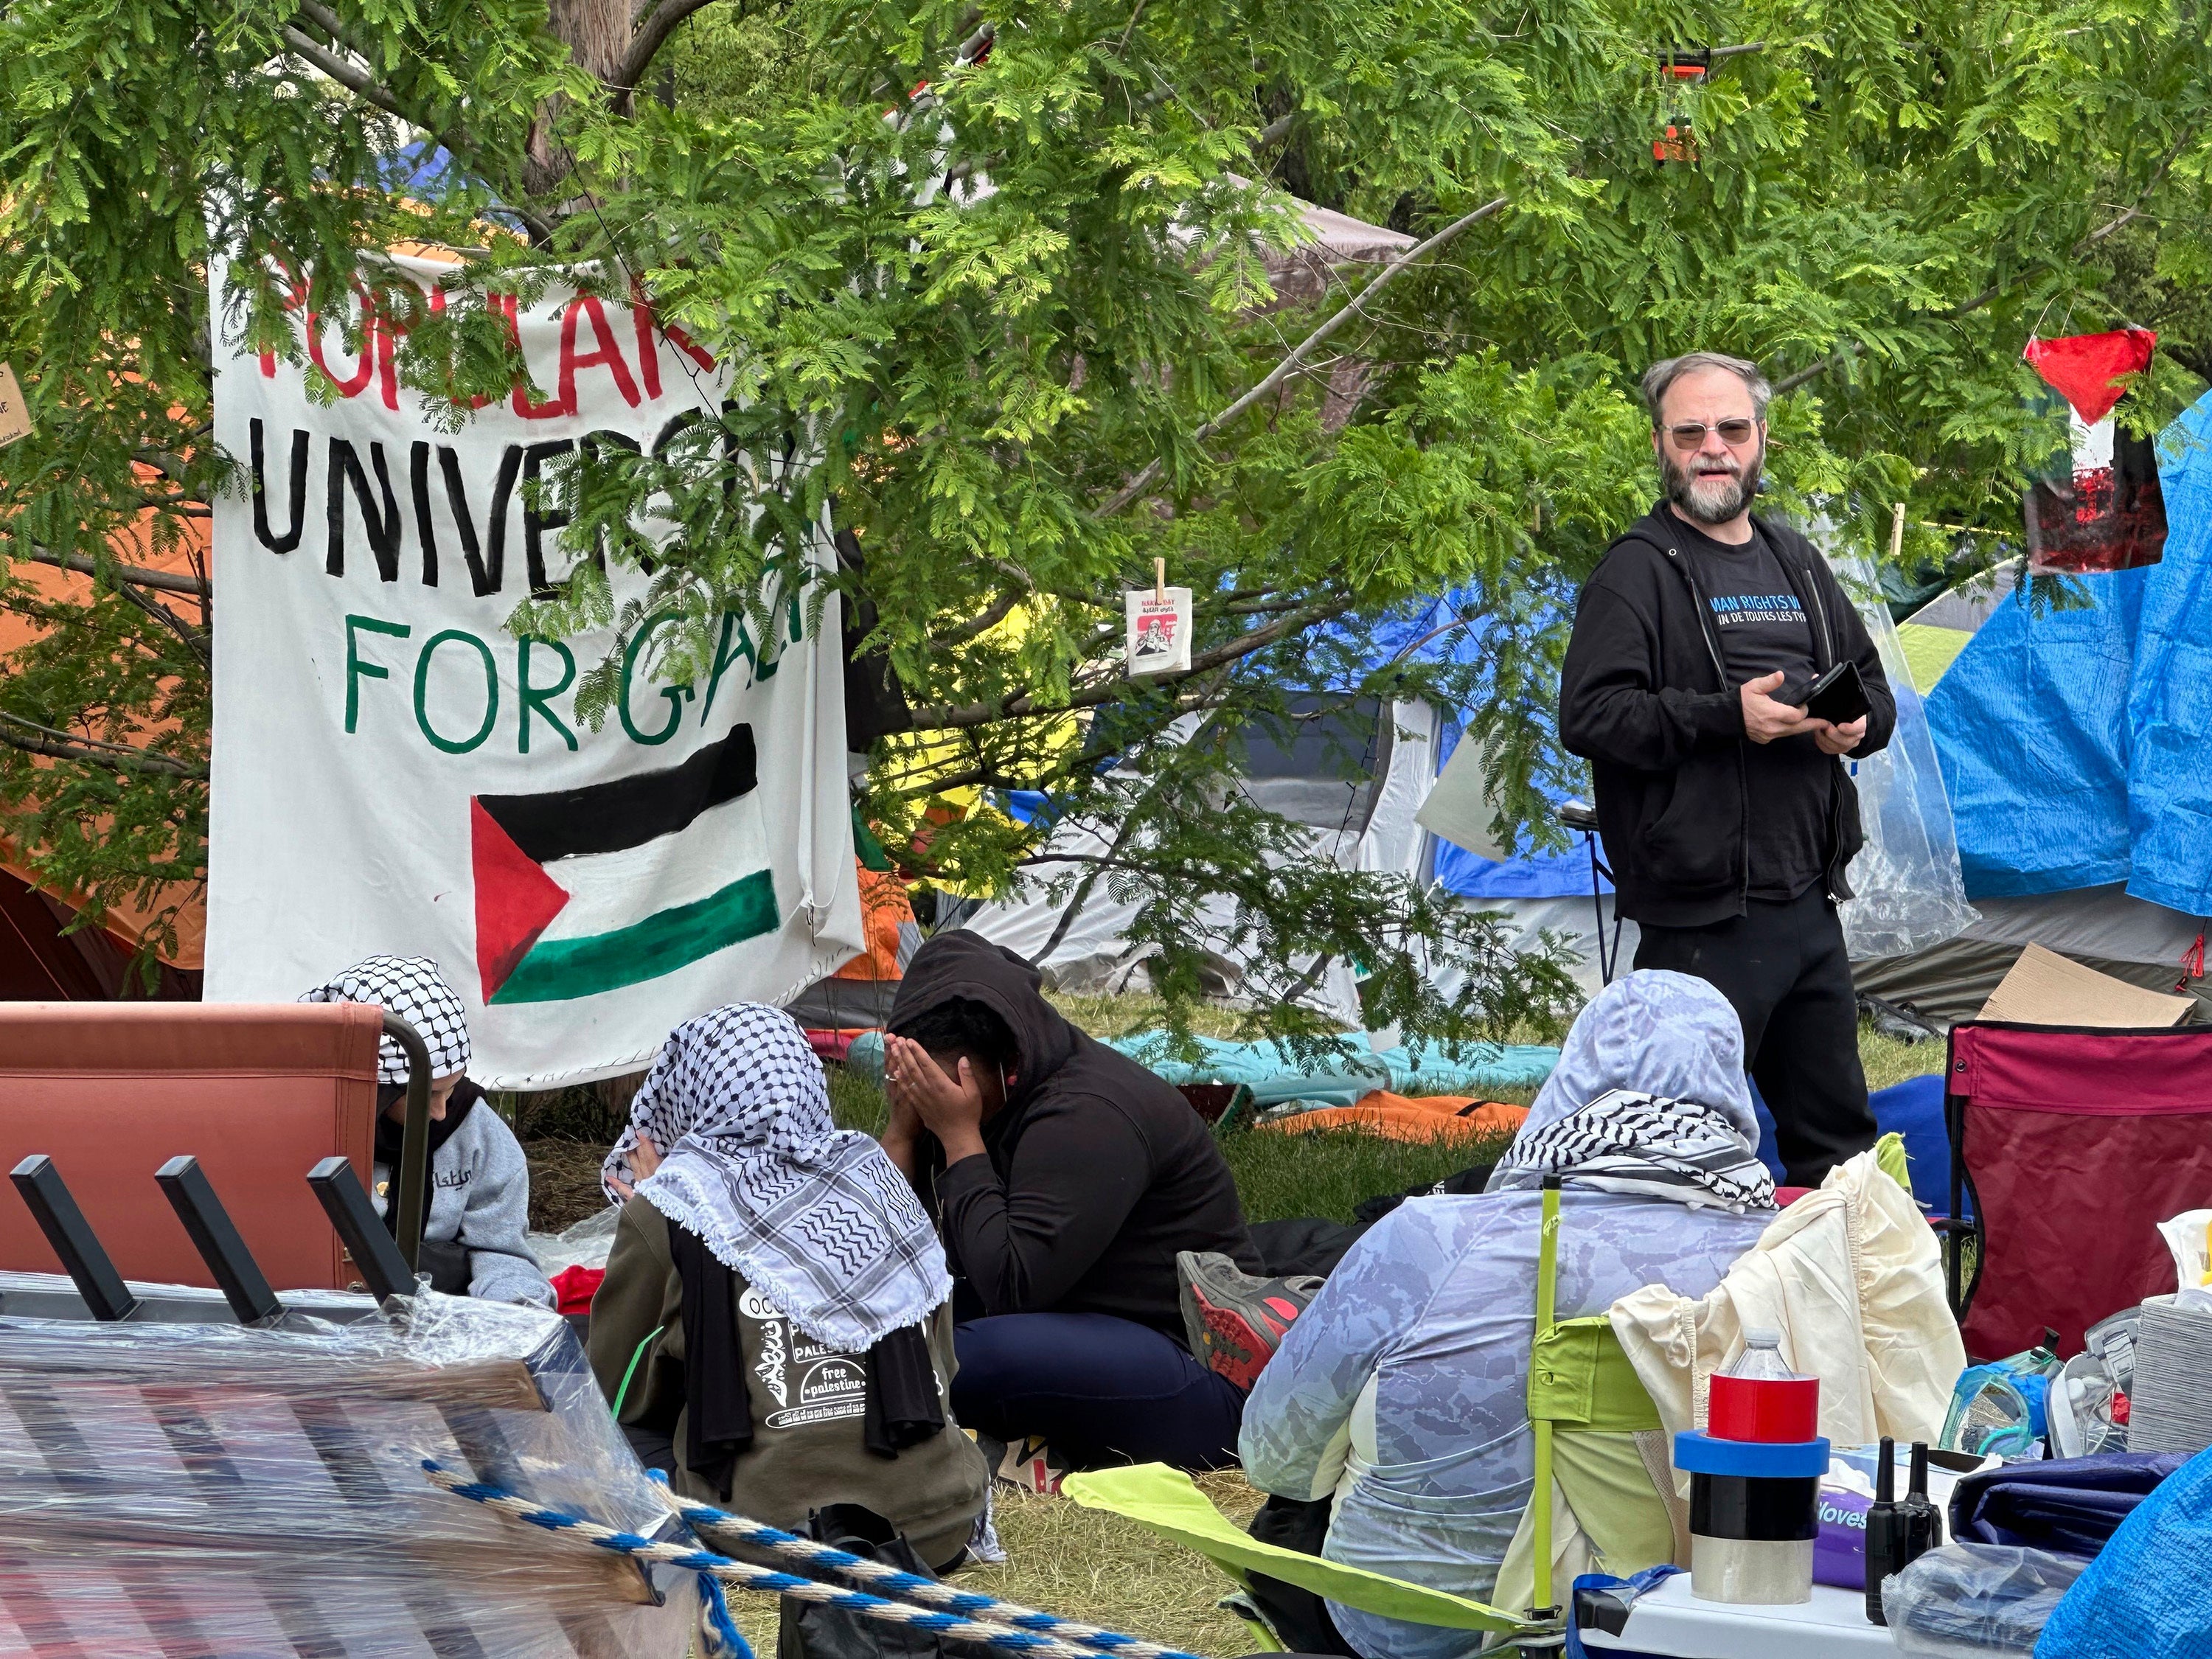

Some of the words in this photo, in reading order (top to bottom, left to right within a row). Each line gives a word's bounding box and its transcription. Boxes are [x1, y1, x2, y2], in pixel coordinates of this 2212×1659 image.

[1739, 594, 1789, 610] RIGHTS
[1730, 611, 1745, 623] DE
[1743, 611, 1776, 622] TOUTES
[1775, 611, 1792, 622] LES
[344, 613, 578, 754] FOR
[821, 1367, 847, 1381] free
[810, 1378, 861, 1398] palestine
